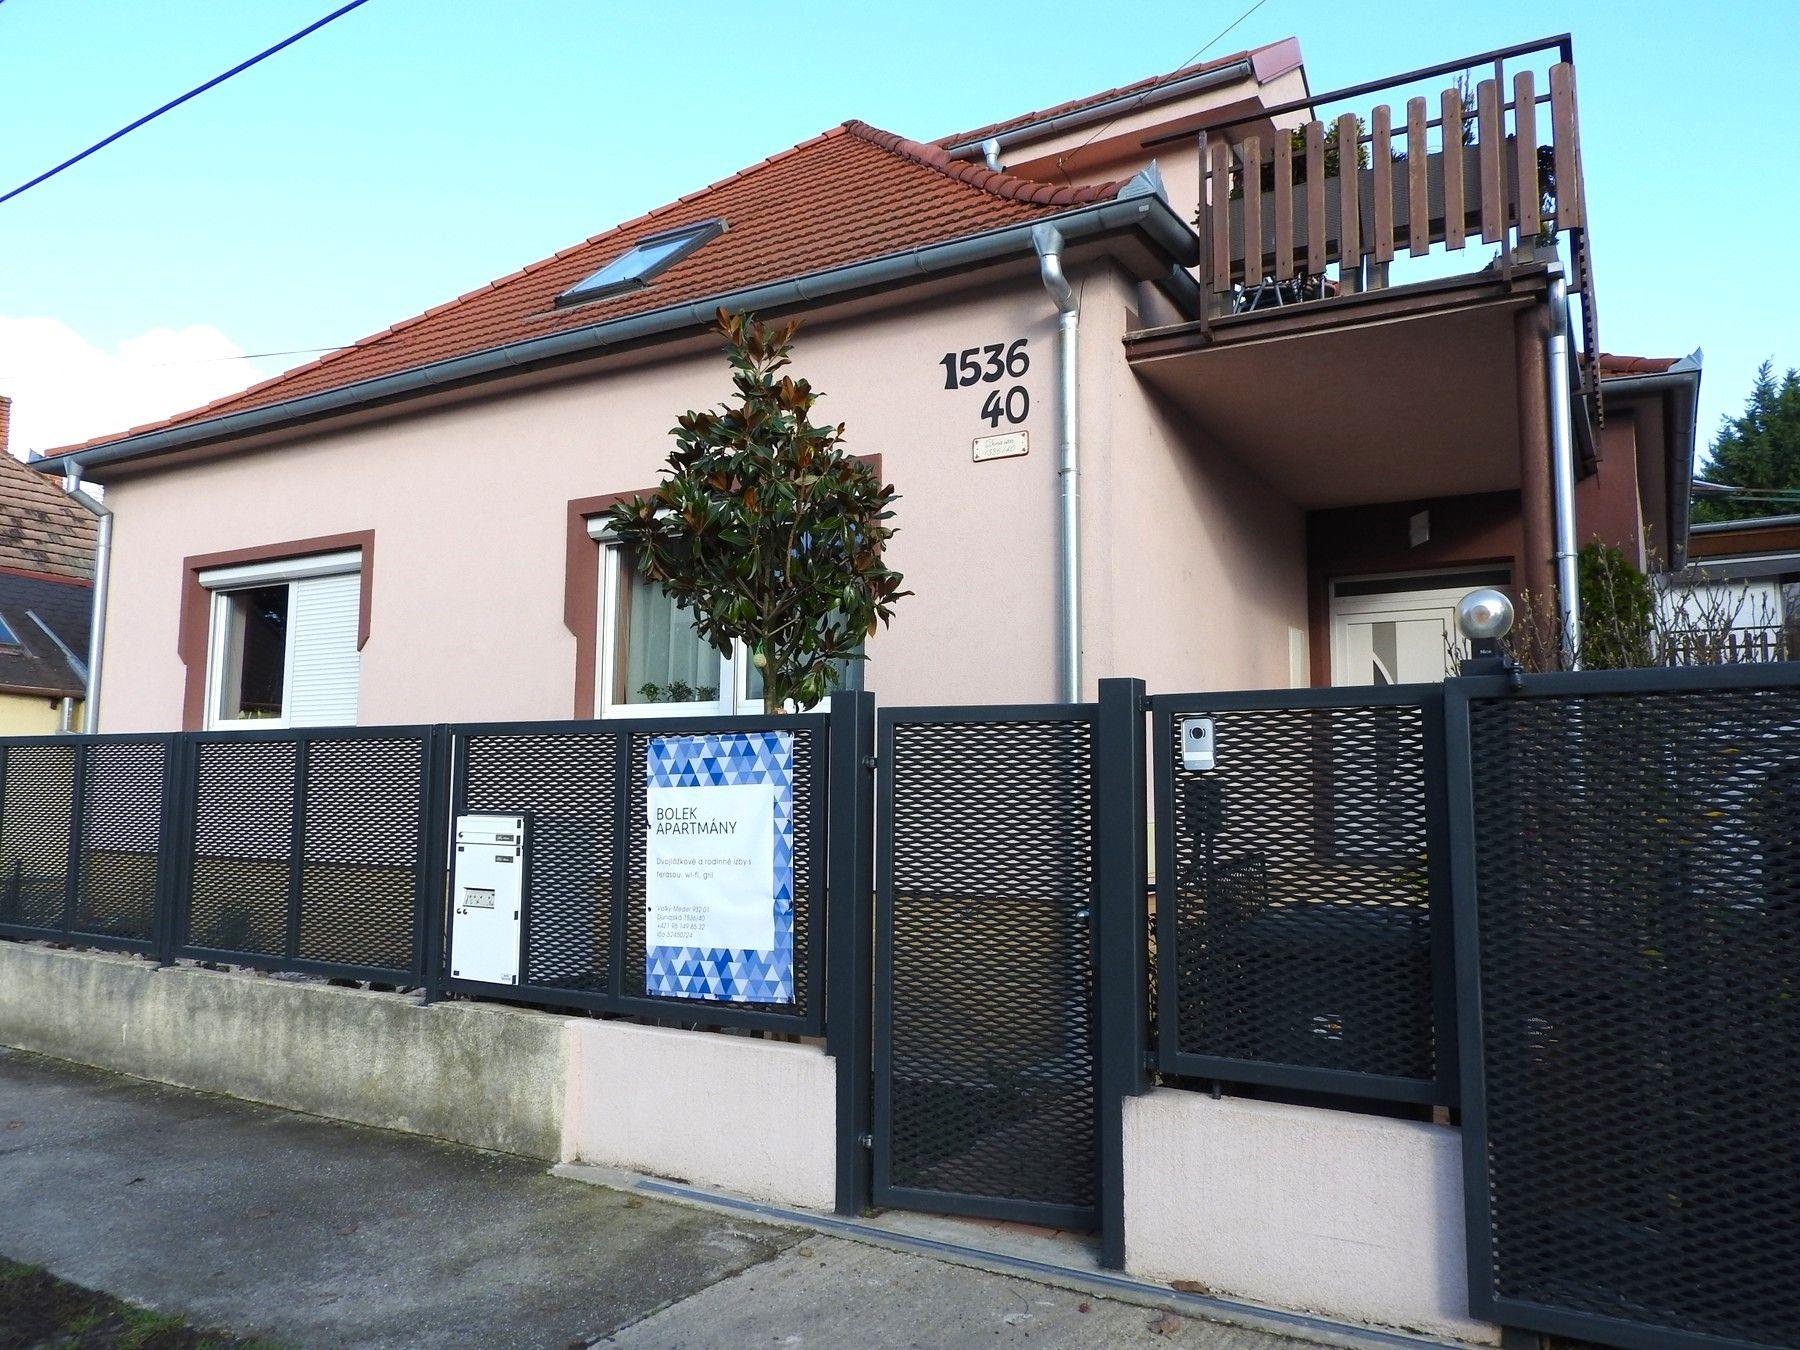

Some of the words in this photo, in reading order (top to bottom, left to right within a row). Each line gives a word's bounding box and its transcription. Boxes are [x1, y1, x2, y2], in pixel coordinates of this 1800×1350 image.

[939, 338, 1030, 389] 1536
[981, 385, 1030, 428] 40
[656, 807, 698, 820] BOLEK
[656, 818, 737, 835] APARTMÁNY
[705, 857, 731, 866] rodinné
